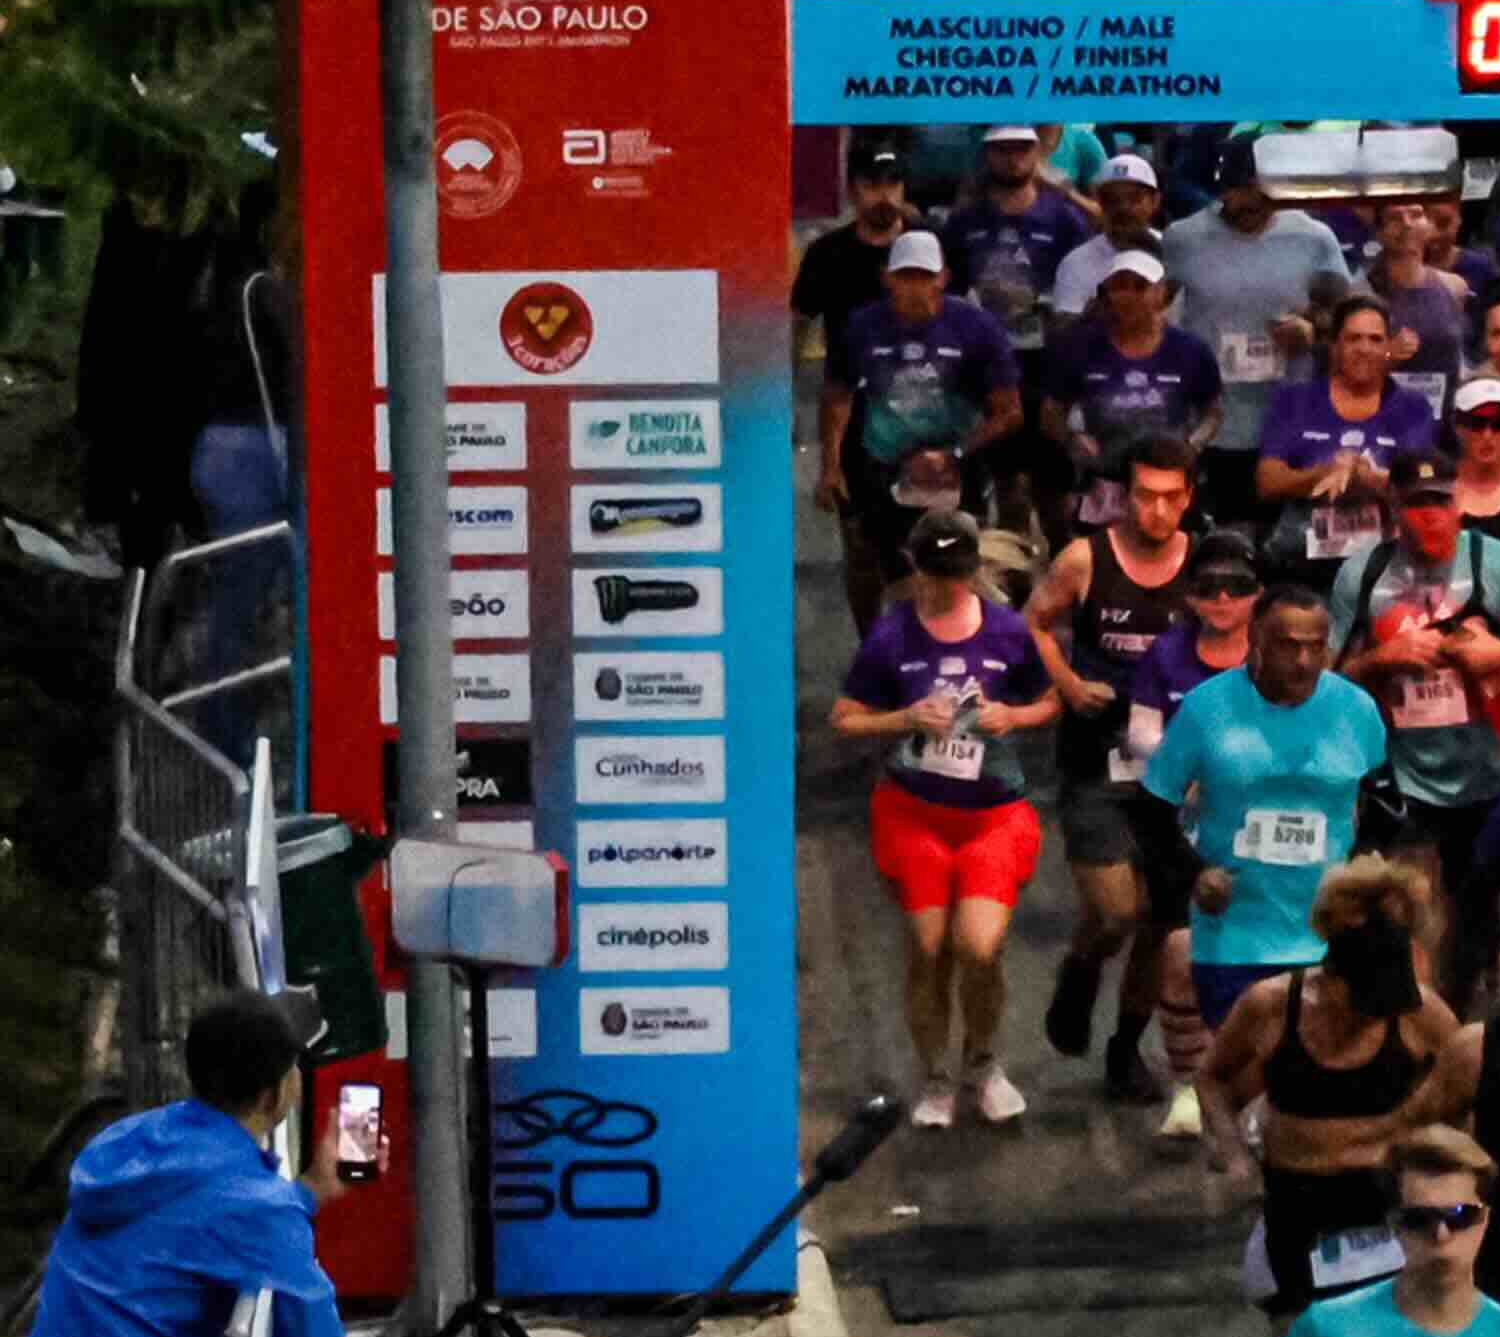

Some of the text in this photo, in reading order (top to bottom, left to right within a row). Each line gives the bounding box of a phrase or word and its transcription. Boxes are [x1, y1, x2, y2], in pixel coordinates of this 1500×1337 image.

[432, 8, 467, 31] DE
[553, 7, 648, 31] PAULO
[890, 17, 1065, 39] MASCULINO
[1100, 17, 1175, 39] MALE
[896, 46, 1037, 68] CHEGADA
[1074, 46, 1169, 67] FINISH
[844, 74, 1015, 98] MARATONA
[1050, 74, 1222, 97] MARATHON
[629, 412, 702, 434] BENDITA
[595, 758, 705, 777] Cunhados
[597, 924, 711, 949] cinépolis
